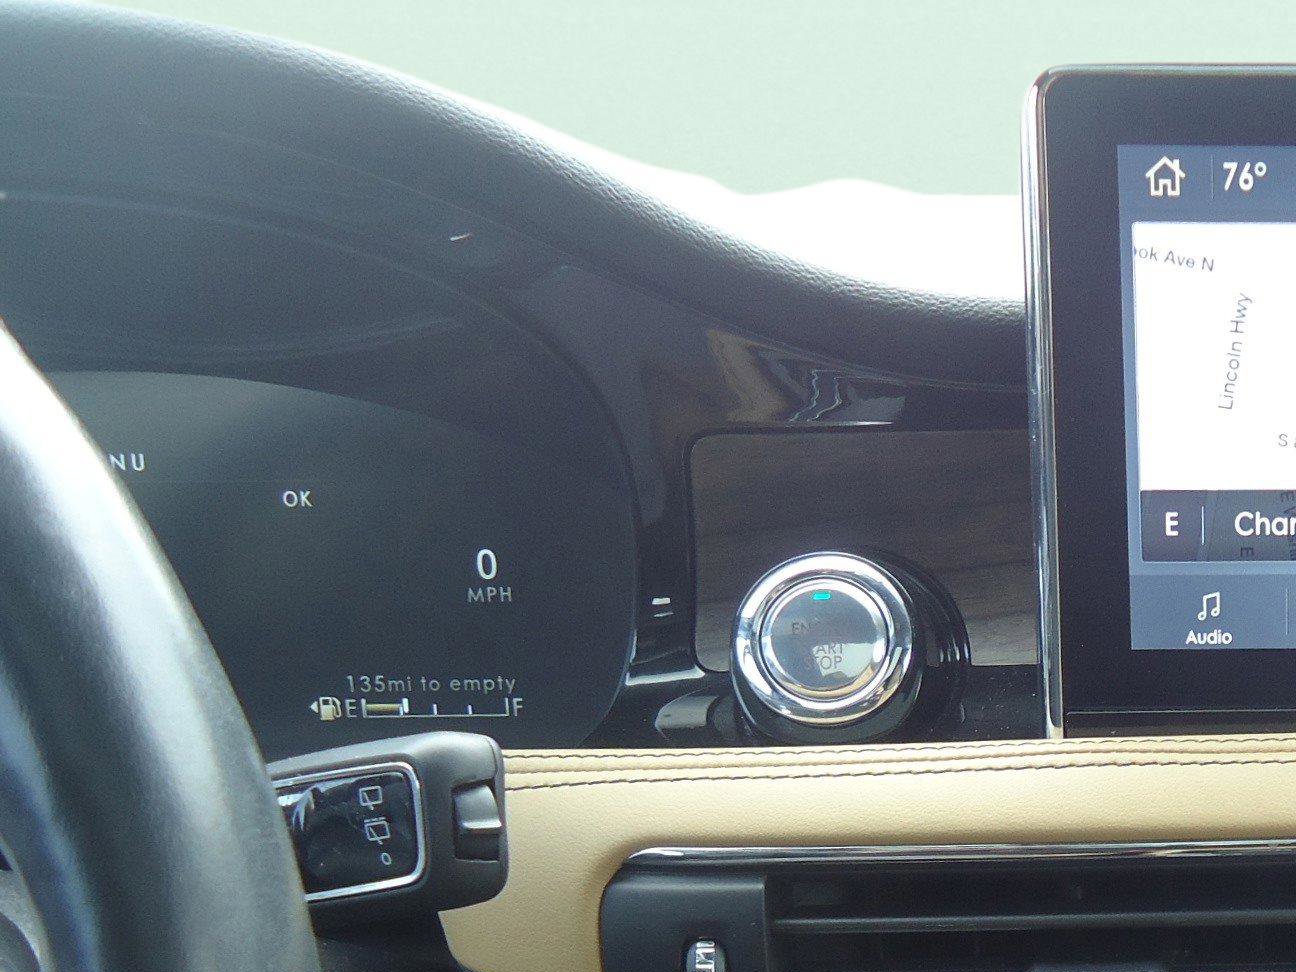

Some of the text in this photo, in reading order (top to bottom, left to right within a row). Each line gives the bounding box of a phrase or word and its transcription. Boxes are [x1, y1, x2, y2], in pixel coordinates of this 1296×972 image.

[1163, 250, 1195, 268] Ave
[1201, 257, 1214, 272] N
[1218, 292, 1253, 410] Lincoln Hwy
[1278, 433, 1289, 448] S
[109, 453, 146, 472] NU
[282, 490, 313, 508] OK
[1165, 511, 1179, 537] E
[476, 548, 498, 580] 0
[467, 586, 513, 603] MPH
[1185, 629, 1233, 646] Audio
[420, 676, 441, 692] to
[450, 675, 517, 695] empty
[345, 698, 358, 718] E
[513, 697, 524, 718] F
